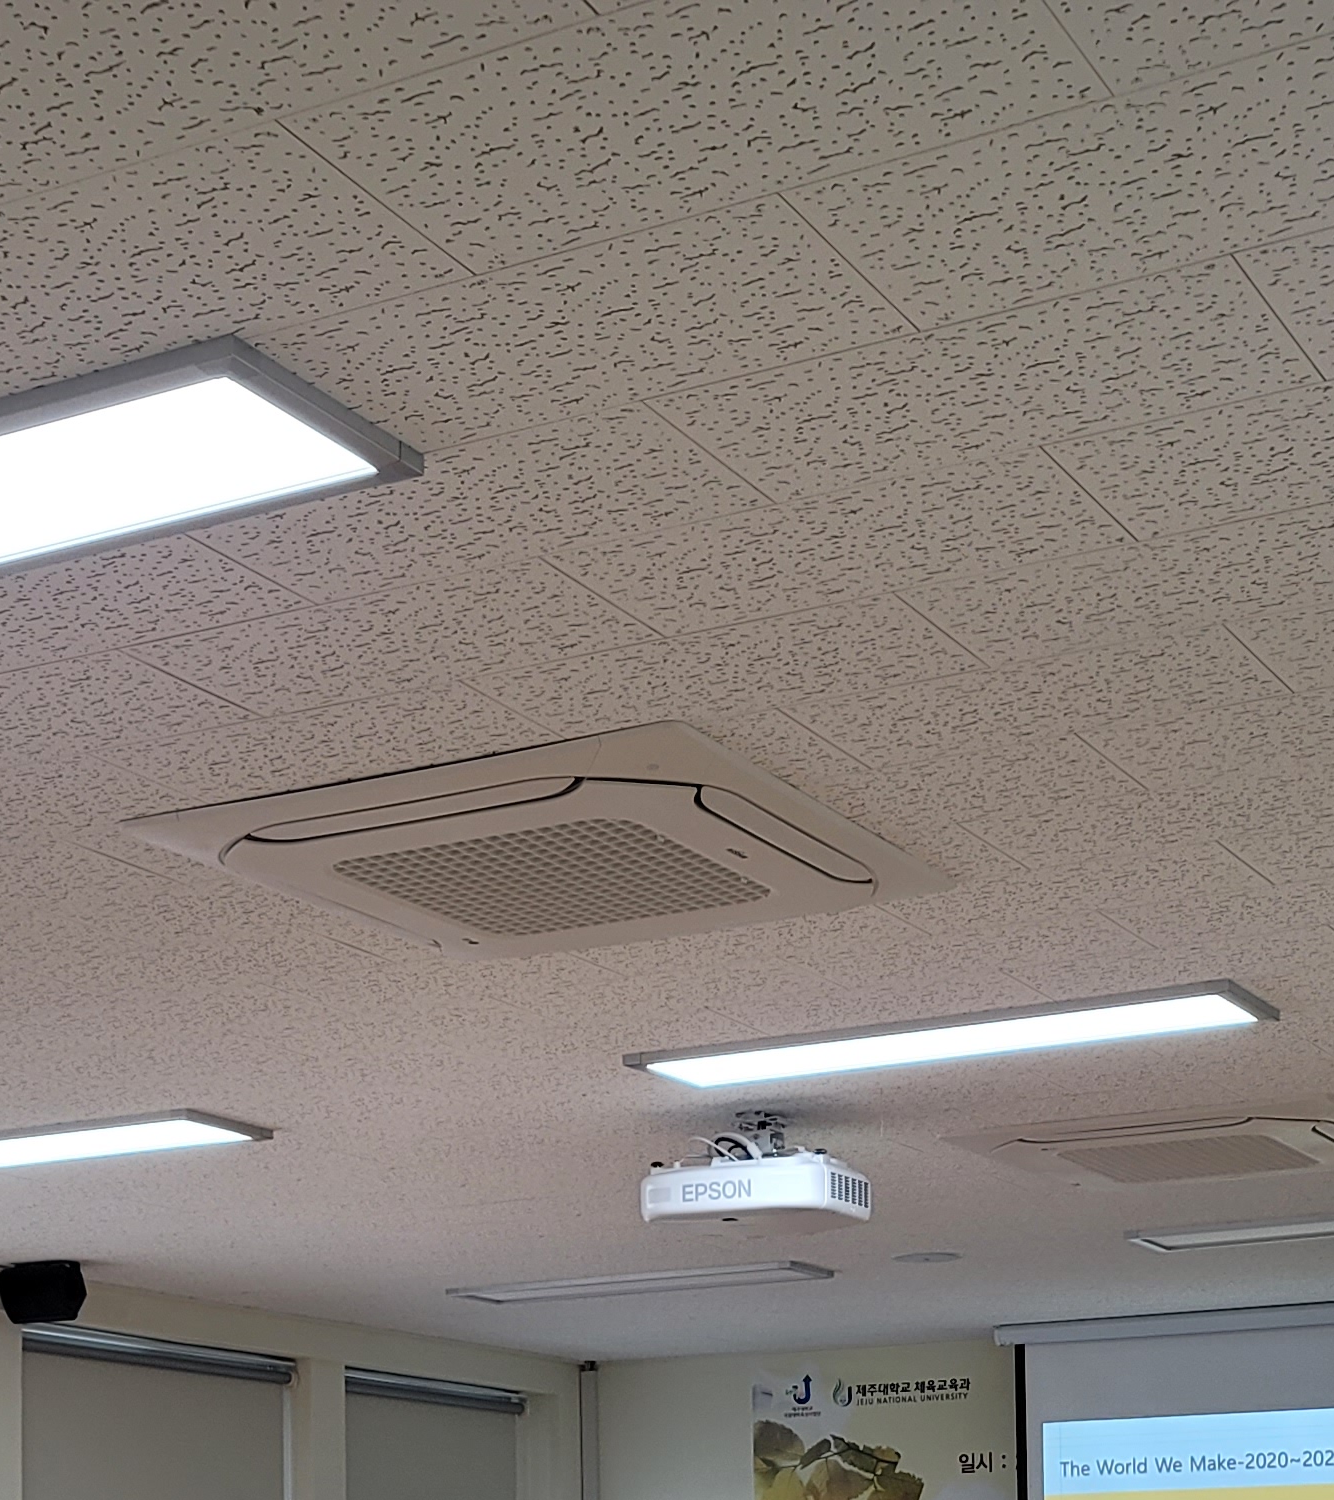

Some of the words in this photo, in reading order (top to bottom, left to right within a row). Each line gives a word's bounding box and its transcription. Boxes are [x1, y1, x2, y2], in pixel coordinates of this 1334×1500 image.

[682, 1179, 751, 1202] EPSON
[855, 1380, 911, 1397] 제주대학교
[913, 1377, 971, 1393] 체육교육과
[876, 1395, 918, 1405] NATIONAL
[920, 1392, 969, 1403] UNIVERSITY
[958, 1452, 993, 1474] 일시
[1059, 1461, 1091, 1478] The
[1096, 1456, 1148, 1476] World
[1154, 1456, 1183, 1474] We
